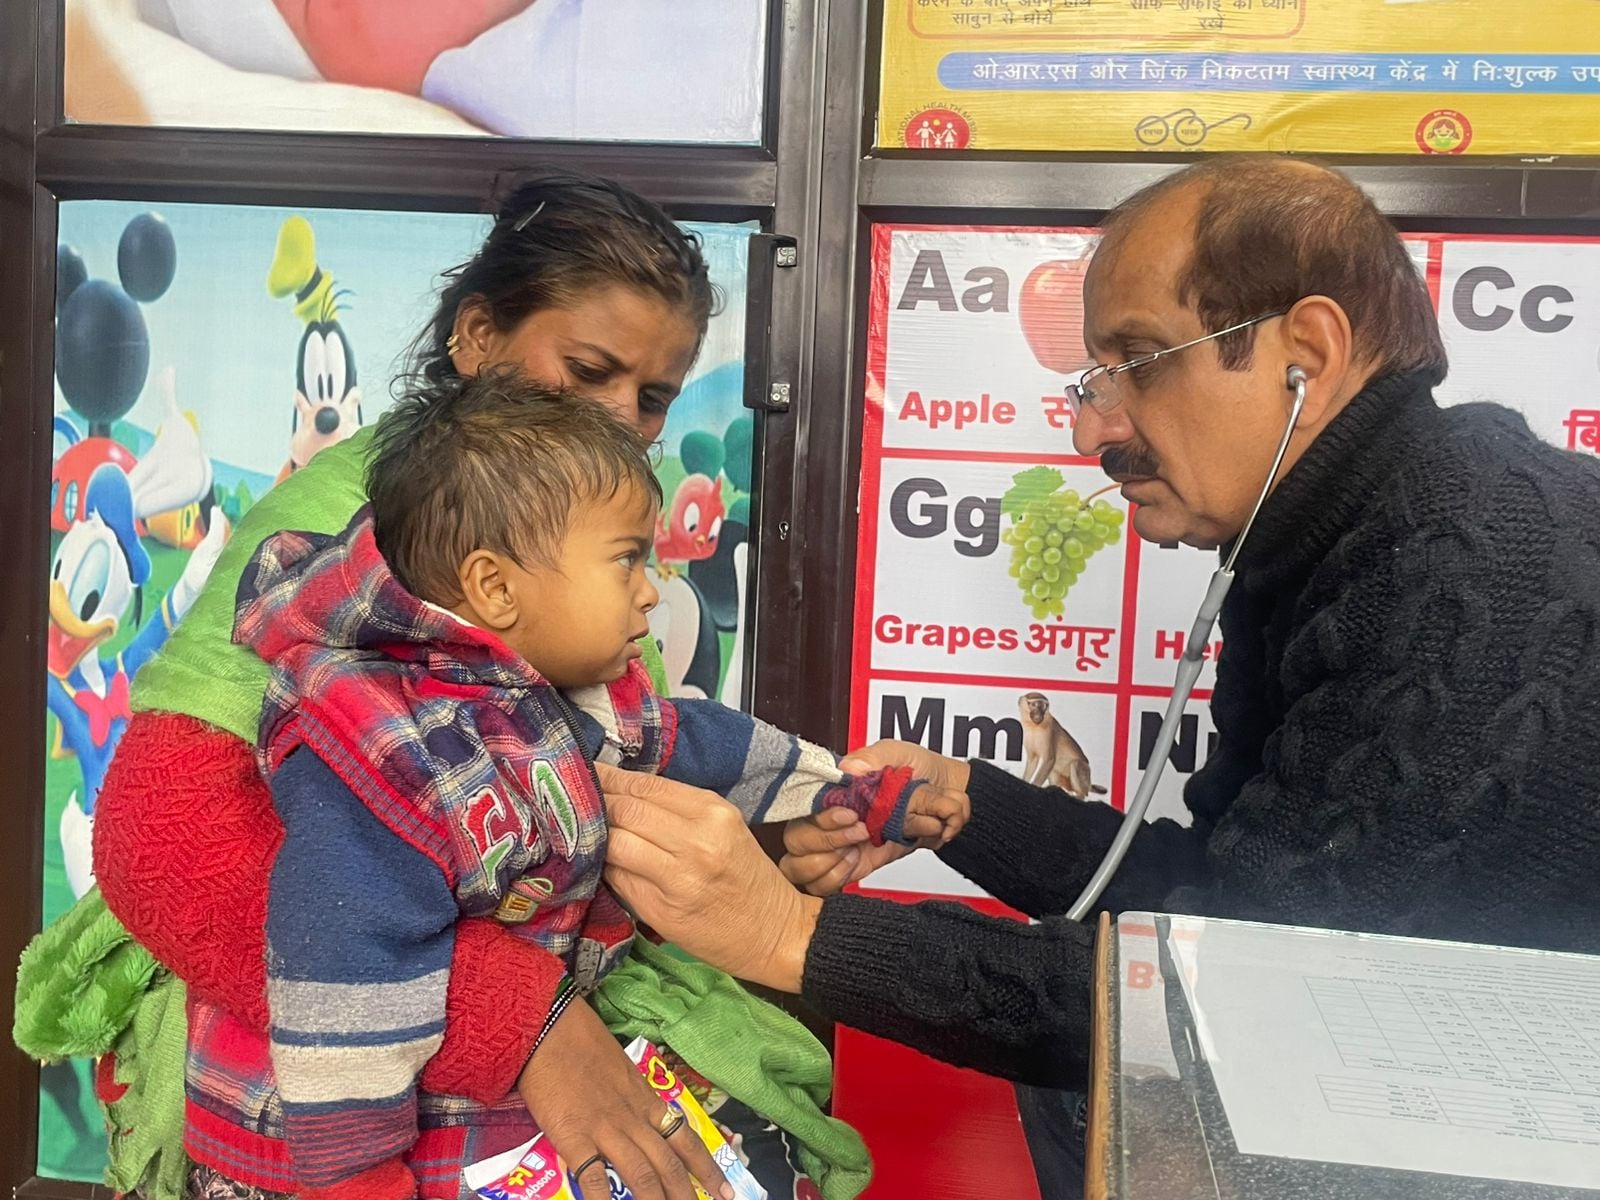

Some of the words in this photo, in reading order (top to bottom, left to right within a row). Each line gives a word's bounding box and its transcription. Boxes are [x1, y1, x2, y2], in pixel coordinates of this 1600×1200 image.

[952, 13, 992, 29] साबुन
[1090, 58, 1128, 80] और
[1201, 59, 1290, 81] निकटतम
[1303, 64, 1376, 81] स्वास्थ्य
[1389, 59, 1428, 82] केंद्र
[1442, 60, 1460, 81] में
[896, 250, 1010, 313] Aa
[1452, 266, 1574, 333] Cc
[898, 391, 1016, 430] Apple
[890, 477, 1002, 557] Gg
[875, 614, 1018, 654] Grapes
[1024, 615, 1115, 672] अंगूर
[879, 694, 1024, 763] Mm
